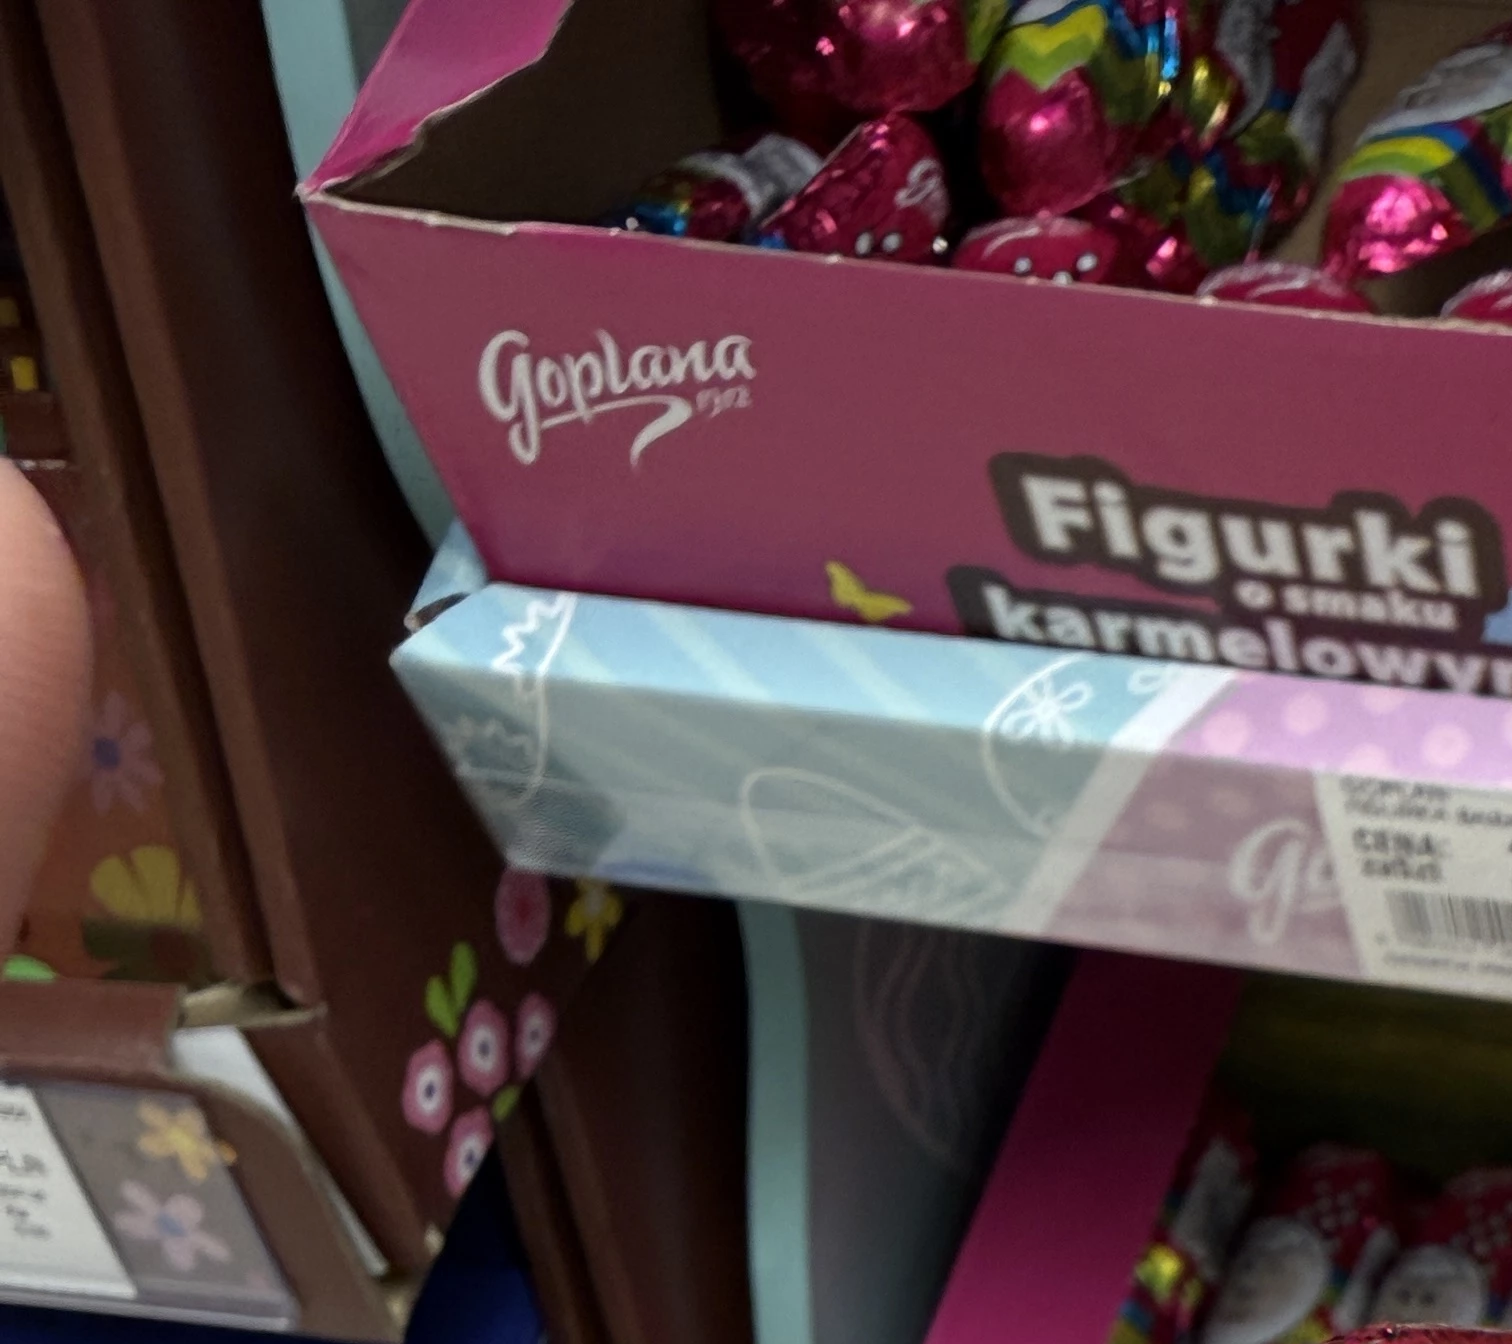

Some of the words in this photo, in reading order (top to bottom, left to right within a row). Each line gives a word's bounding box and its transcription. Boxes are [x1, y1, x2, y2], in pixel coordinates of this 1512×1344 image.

[478, 328, 758, 465] Goplana
[1020, 472, 1483, 599] Figurki
[1232, 577, 1274, 609] o
[1281, 582, 1459, 631] smaku
